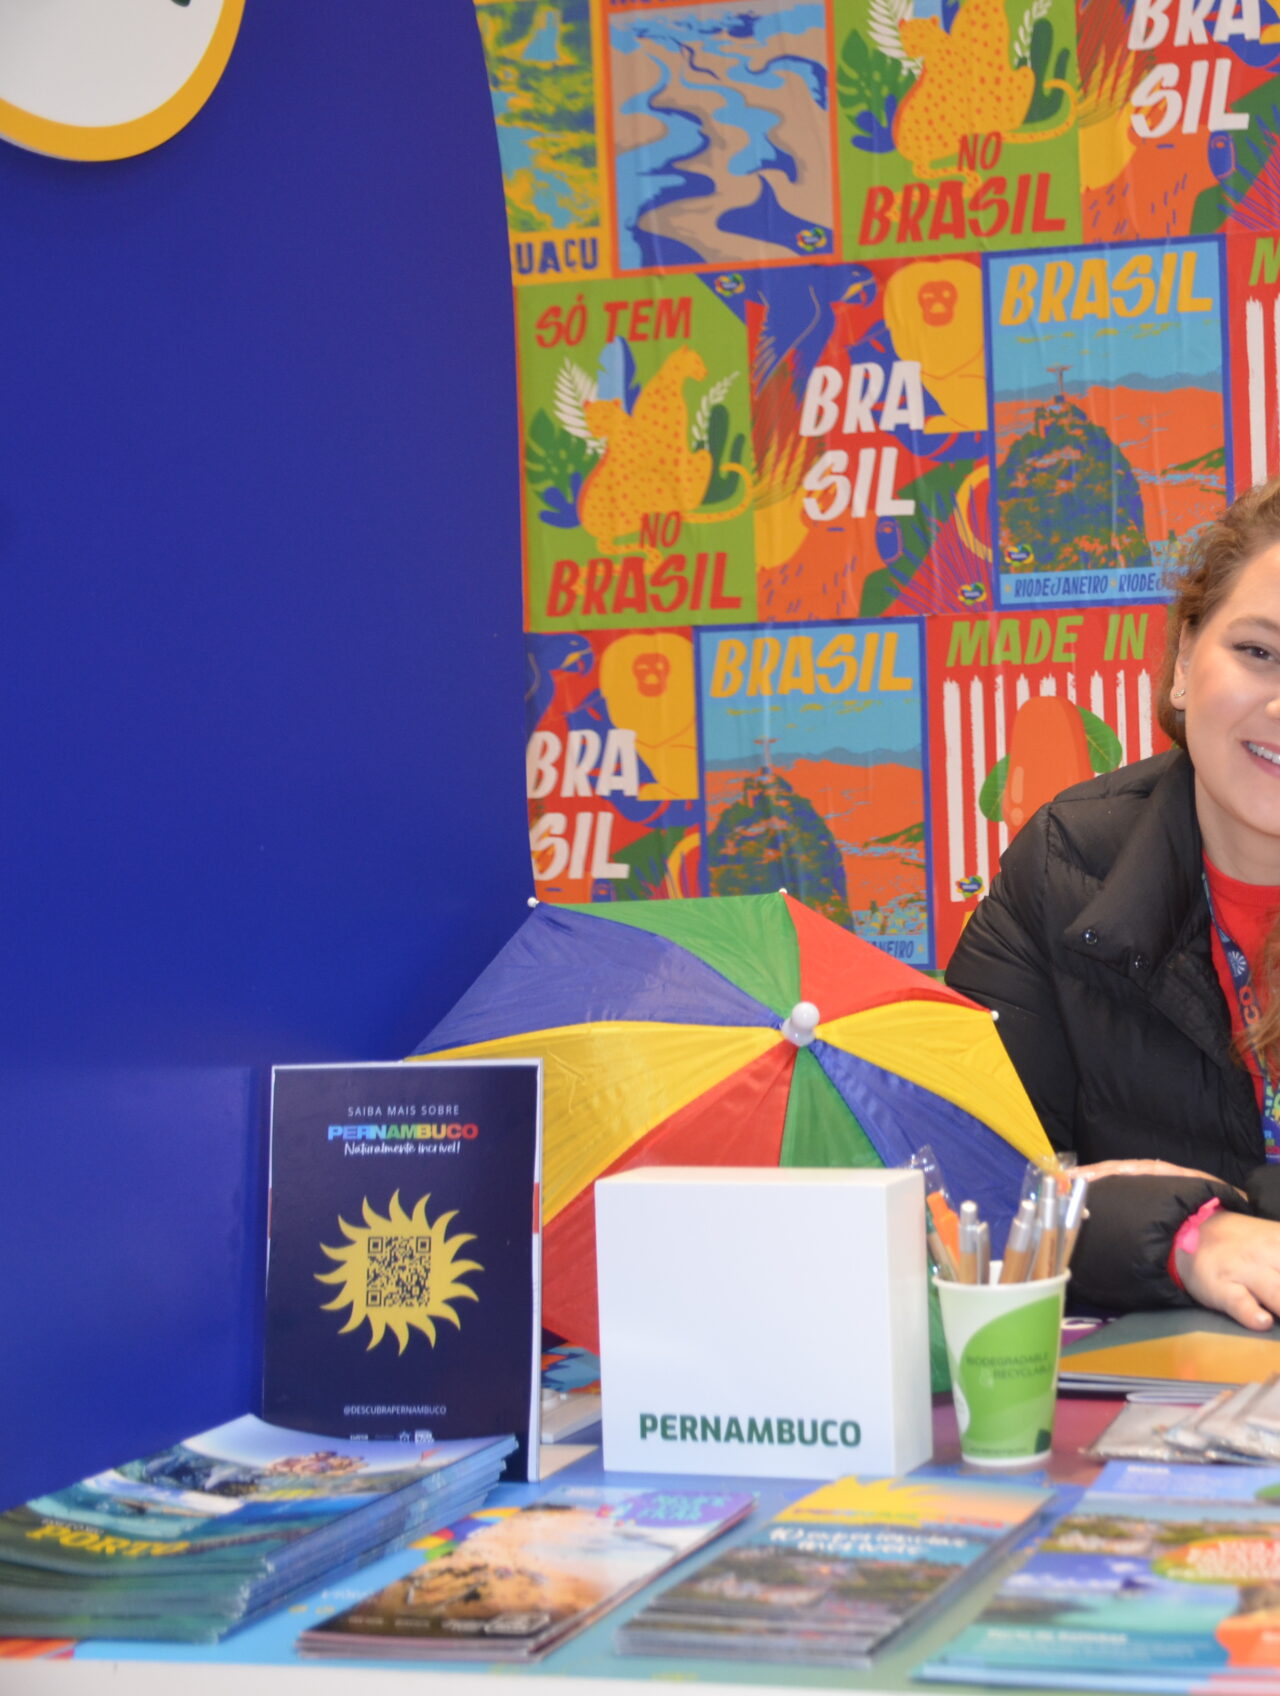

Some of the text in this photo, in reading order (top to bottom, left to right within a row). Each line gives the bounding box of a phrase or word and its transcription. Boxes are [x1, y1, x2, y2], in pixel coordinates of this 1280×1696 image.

[1127, 0, 1261, 51] BRA
[1130, 57, 1250, 139] SIL
[957, 131, 1002, 172] NO
[858, 172, 1067, 246] BRASIL
[999, 251, 1213, 327] BRASIL
[535, 294, 694, 348] SÓ TEM
[800, 361, 925, 437] BRA
[802, 446, 915, 521] SIL
[639, 511, 681, 550] NO
[546, 552, 743, 617] BRASIL
[709, 632, 914, 698] BRASIL
[946, 613, 1148, 667] MADE IN
[527, 729, 639, 799] BRA
[531, 811, 629, 881] SIL
[327, 1123, 479, 1141] PERNAMBUCO
[347, 1105, 460, 1117] SAIBA MAIS SOBRE
[343, 1404, 448, 1417] @DESCUBRAPERNAMBUCO
[639, 1413, 862, 1447] PERNAMBUCO
